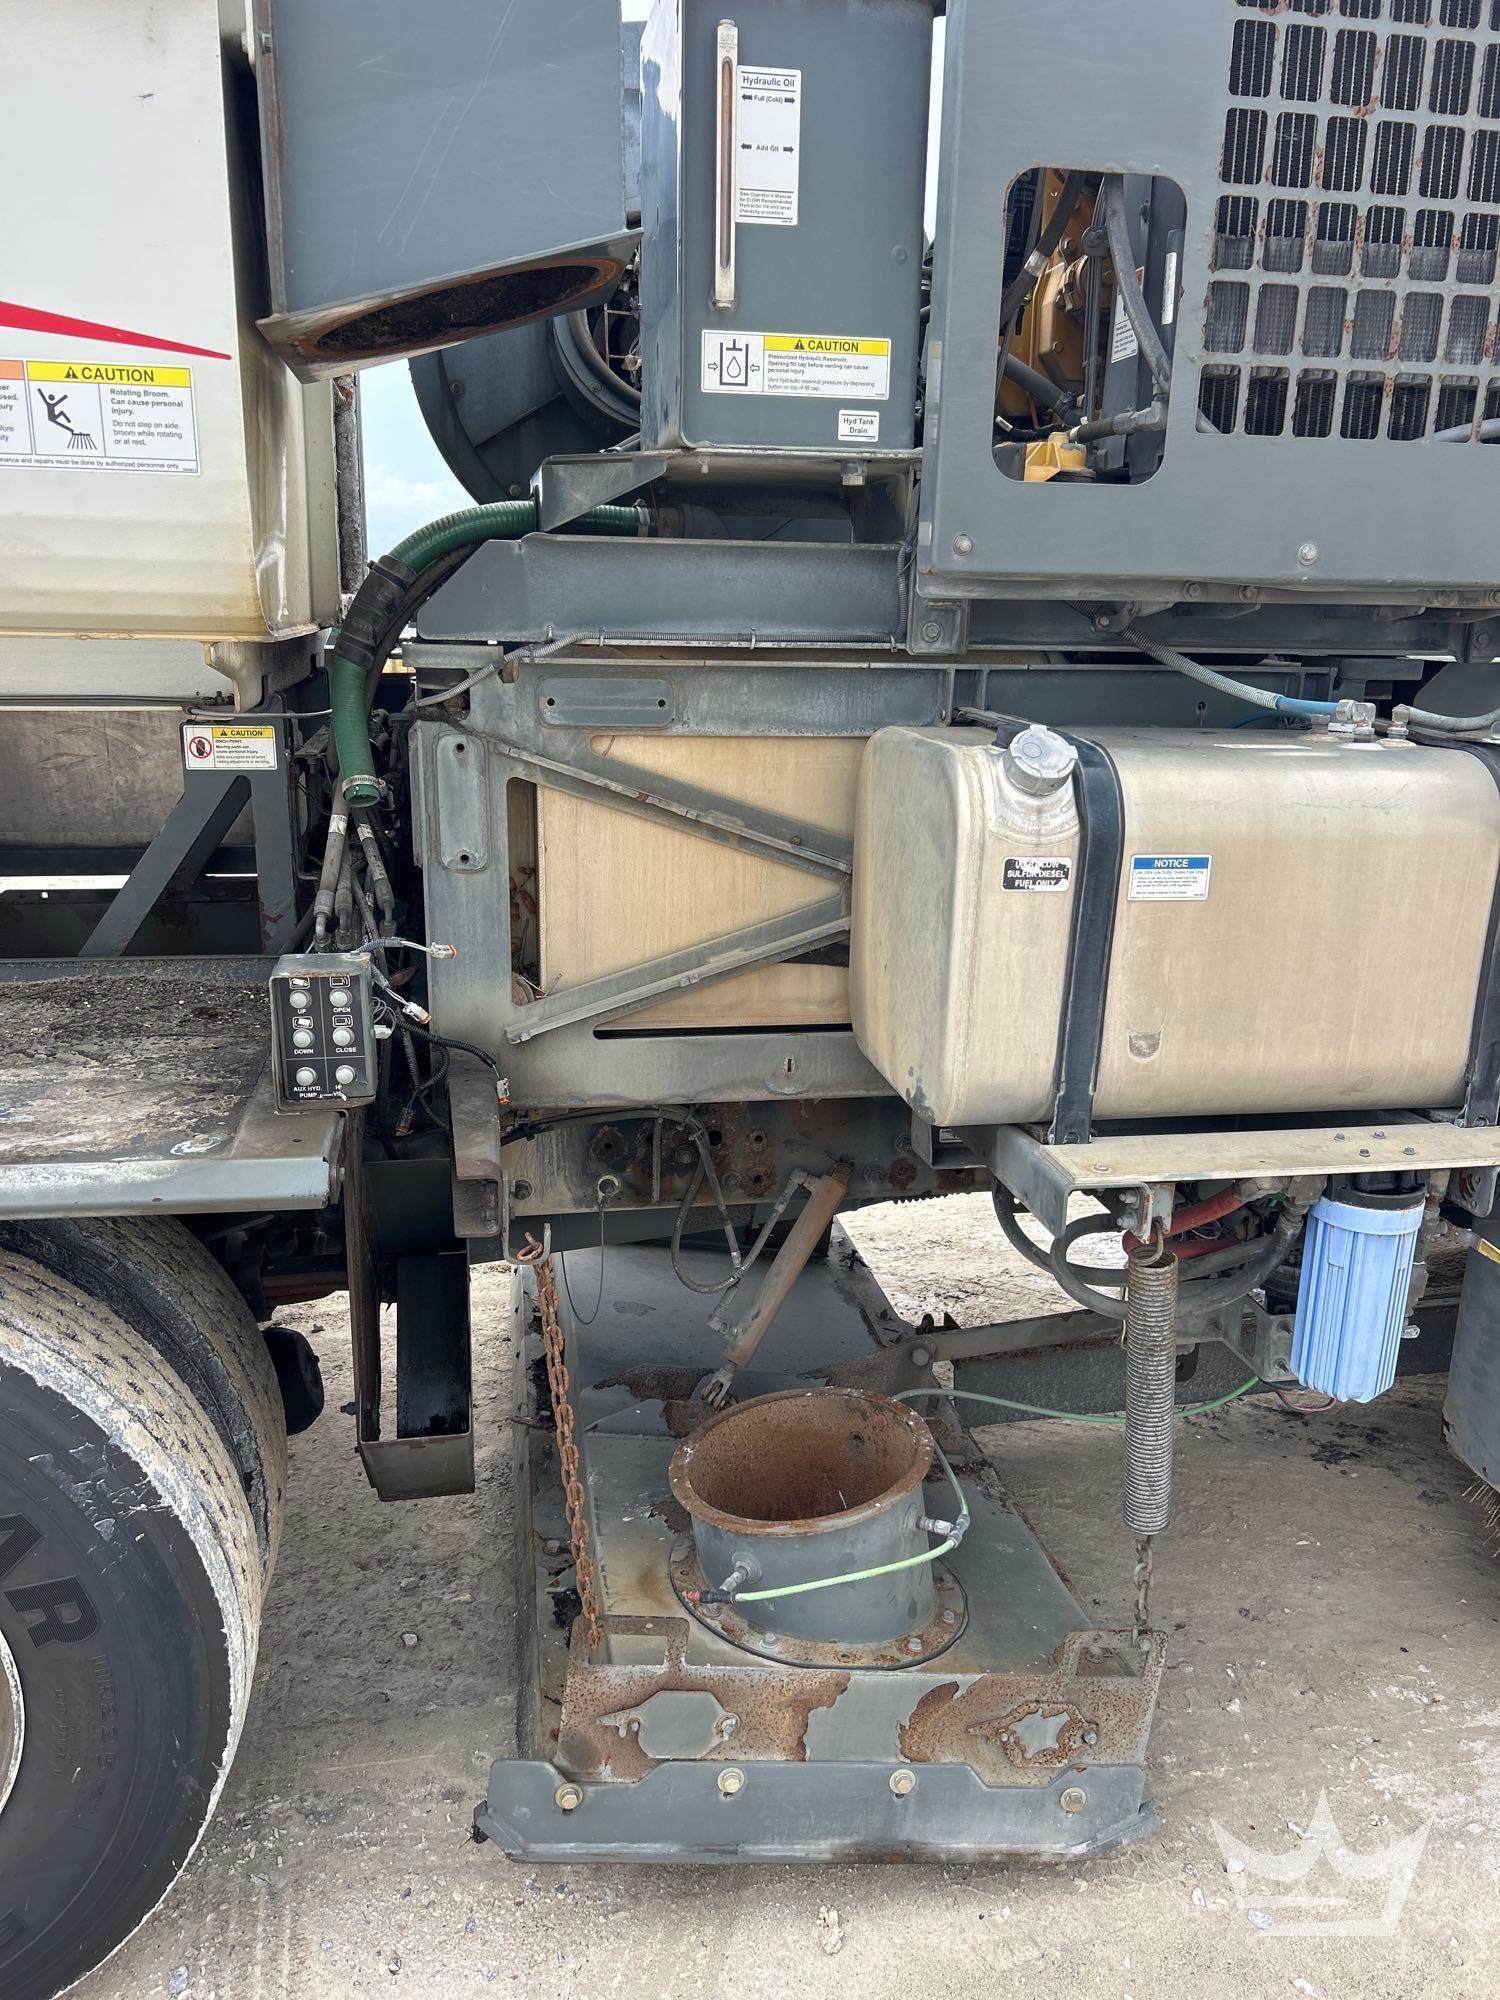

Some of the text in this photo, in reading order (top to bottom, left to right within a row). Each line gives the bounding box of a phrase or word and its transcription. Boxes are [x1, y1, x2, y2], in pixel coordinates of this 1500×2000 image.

[742, 75, 795, 87] Hydraulic Oil
[754, 94, 784, 104] Full (Cold)
[808, 340, 859, 352] CAUTION
[82, 366, 154, 382] CAUTION
[110, 388, 170, 398] Rotating Broom.
[156, 432, 182, 440] rotating
[1154, 859, 1189, 868] NOTICE
[1015, 879, 1034, 887] FUEL
